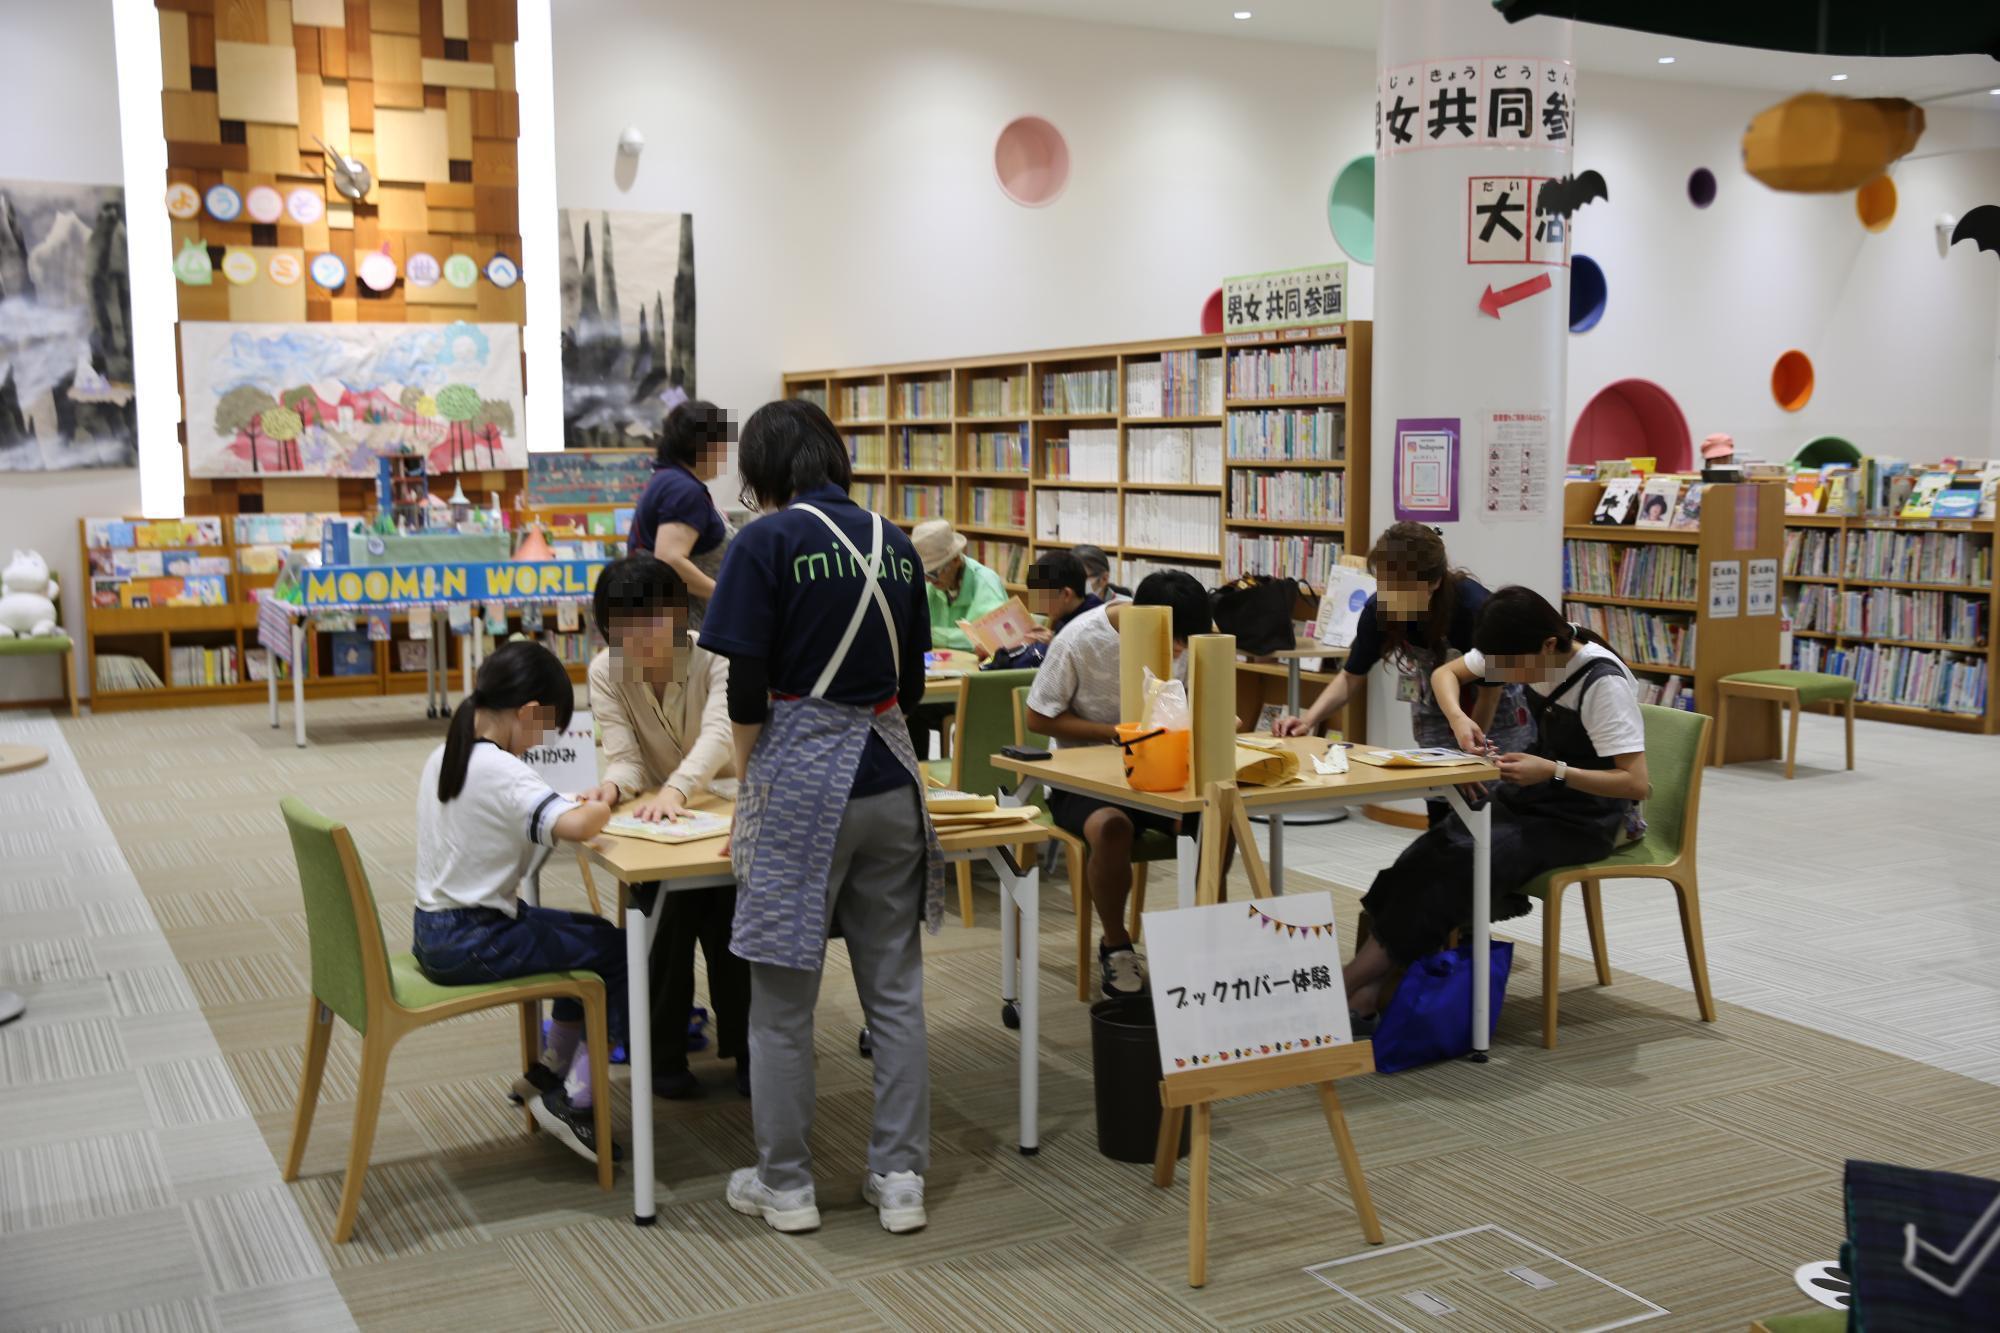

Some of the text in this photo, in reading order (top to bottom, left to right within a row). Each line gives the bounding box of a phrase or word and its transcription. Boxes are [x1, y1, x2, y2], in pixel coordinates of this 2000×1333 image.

[1375, 86, 1576, 146] 女共同参
[183, 253, 513, 283] ムーミン世界へ
[1226, 283, 1342, 326] 男女共同参画
[306, 566, 468, 604] MOOMIN
[1165, 965, 1332, 1010] ブックカバー体験
